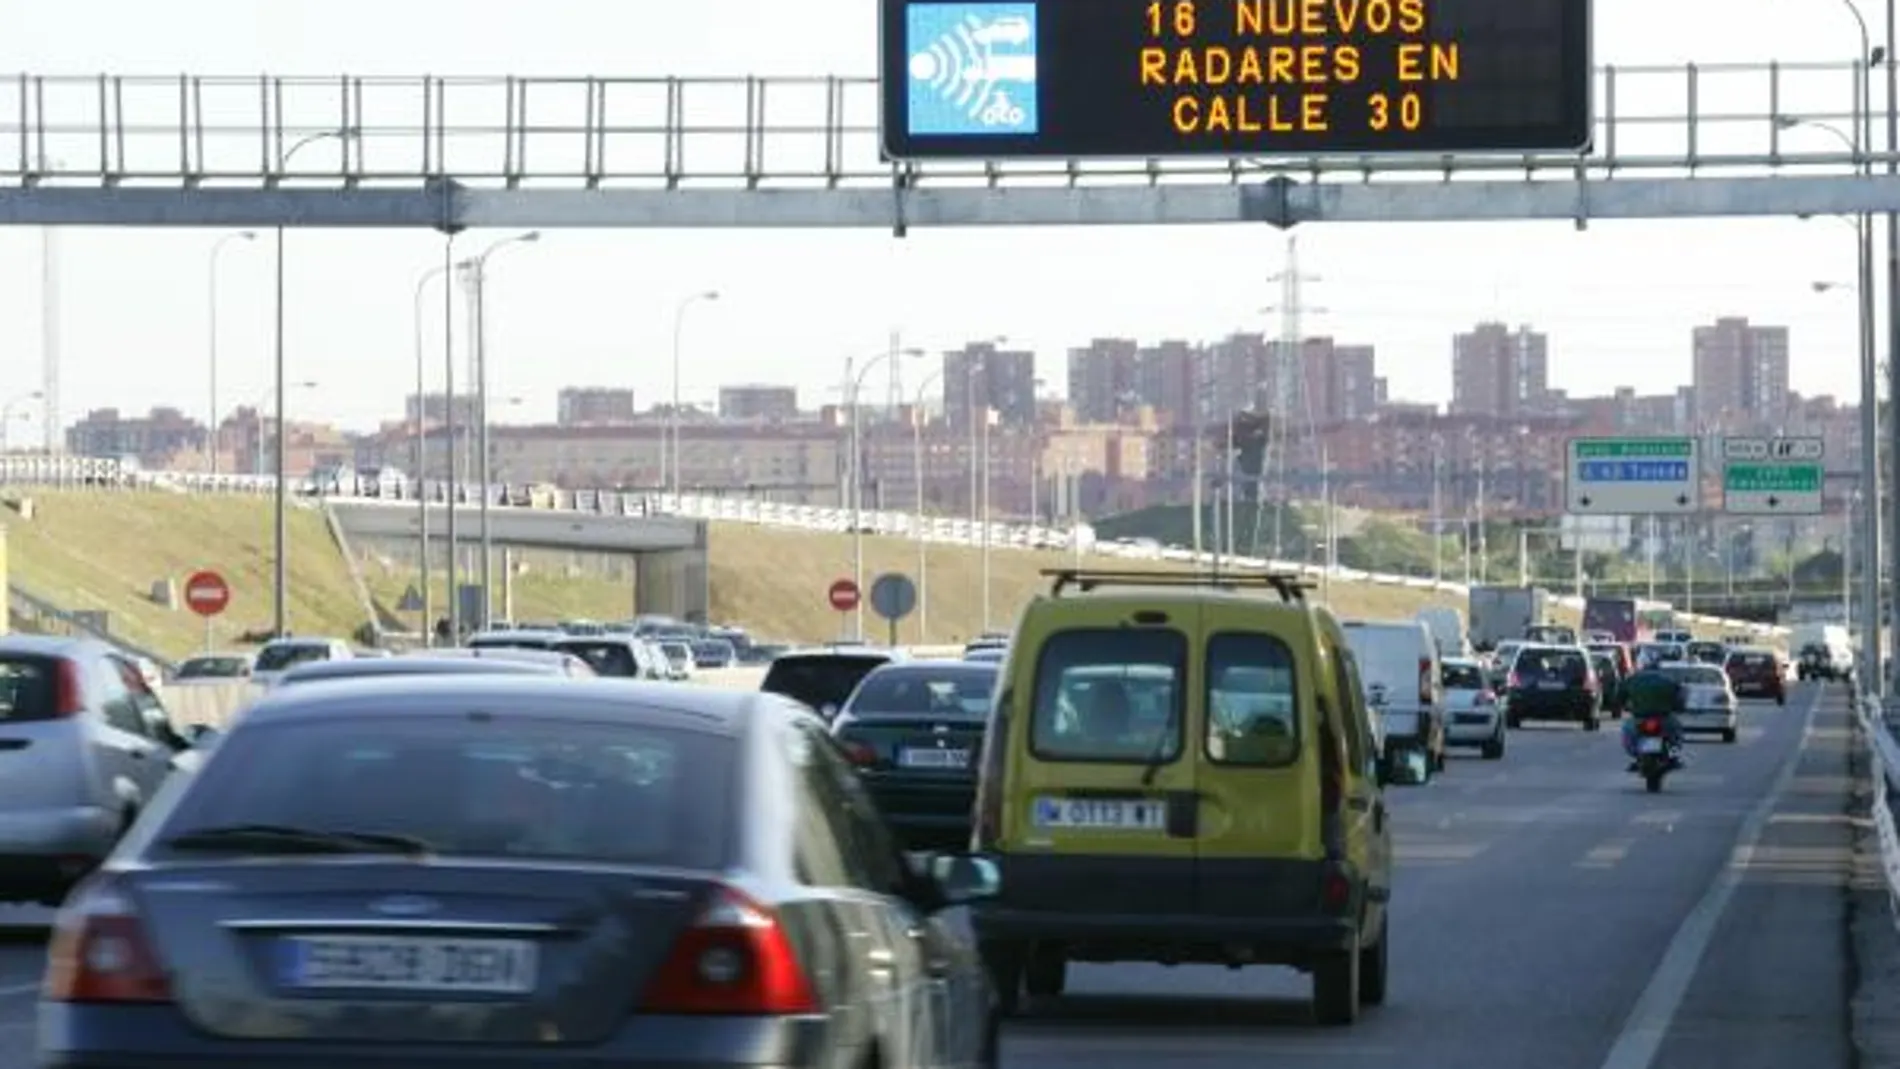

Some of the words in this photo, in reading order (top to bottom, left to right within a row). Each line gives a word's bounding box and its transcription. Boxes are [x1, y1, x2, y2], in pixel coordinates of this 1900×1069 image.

[1148, 0, 1195, 36] 16
[1237, 0, 1424, 35] NUEVOS
[1140, 45, 1360, 84] RADARES
[1398, 43, 1458, 81] EN
[1173, 93, 1327, 133] CALLE
[1368, 92, 1420, 130] 30
